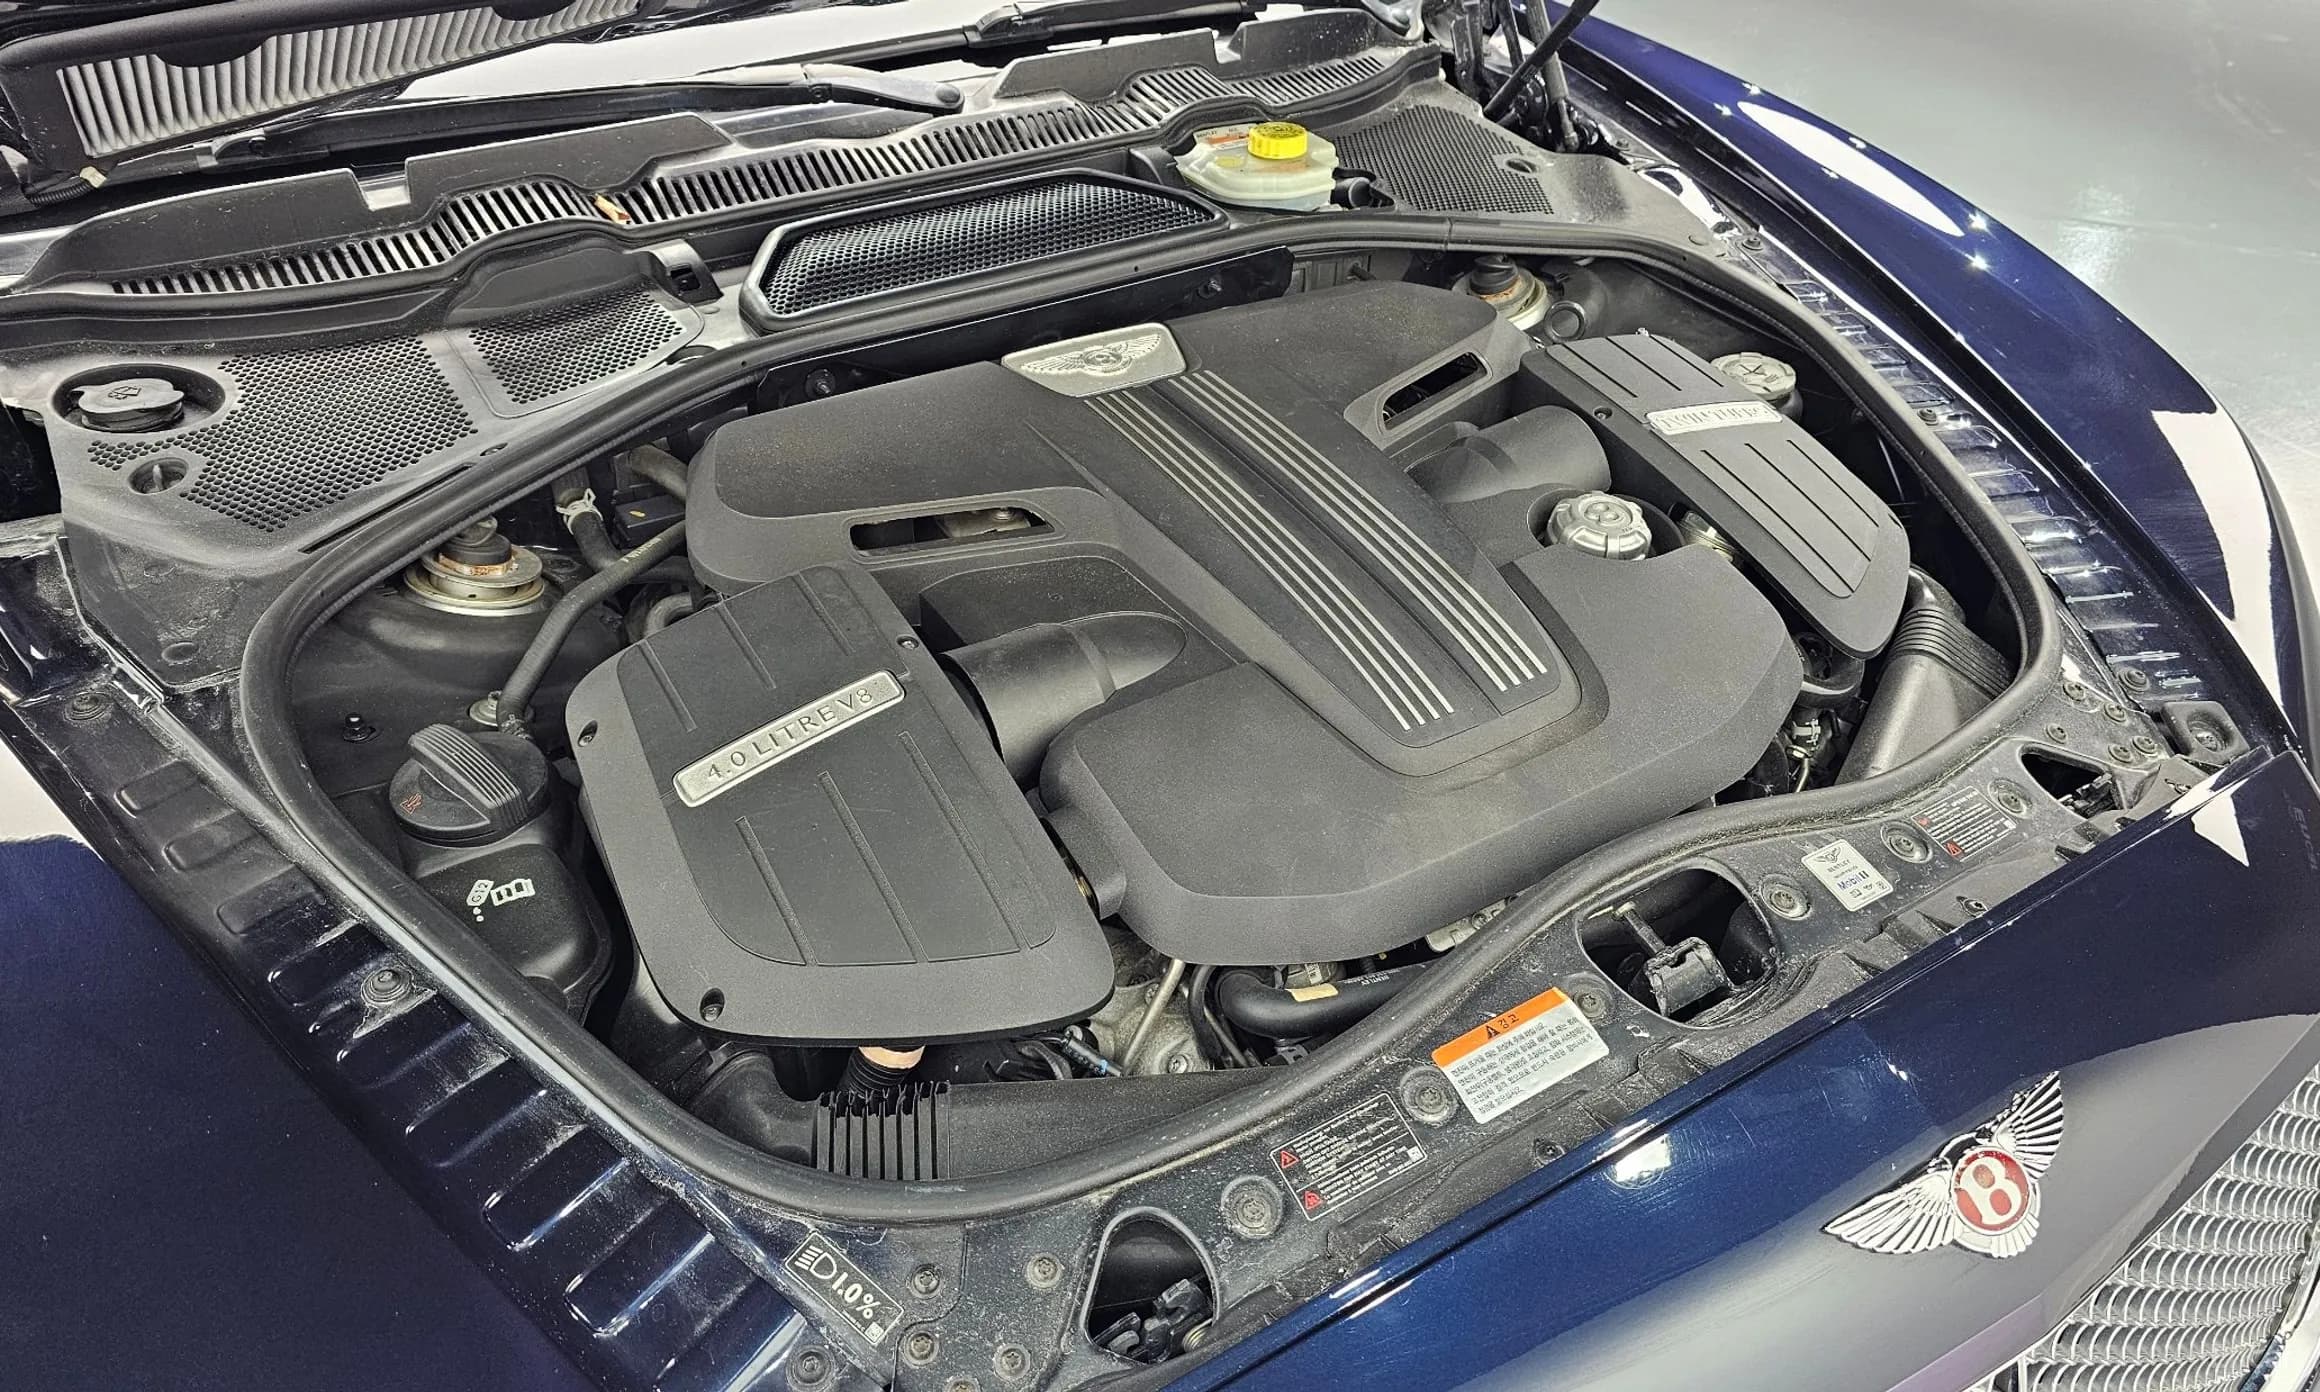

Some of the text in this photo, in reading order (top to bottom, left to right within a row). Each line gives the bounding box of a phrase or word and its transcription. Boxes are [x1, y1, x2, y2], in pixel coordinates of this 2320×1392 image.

[708, 687, 872, 780] 4.0 LITRE V8
[1498, 1014, 1520, 1028] 경고
[832, 1272, 880, 1319] 1.0%
